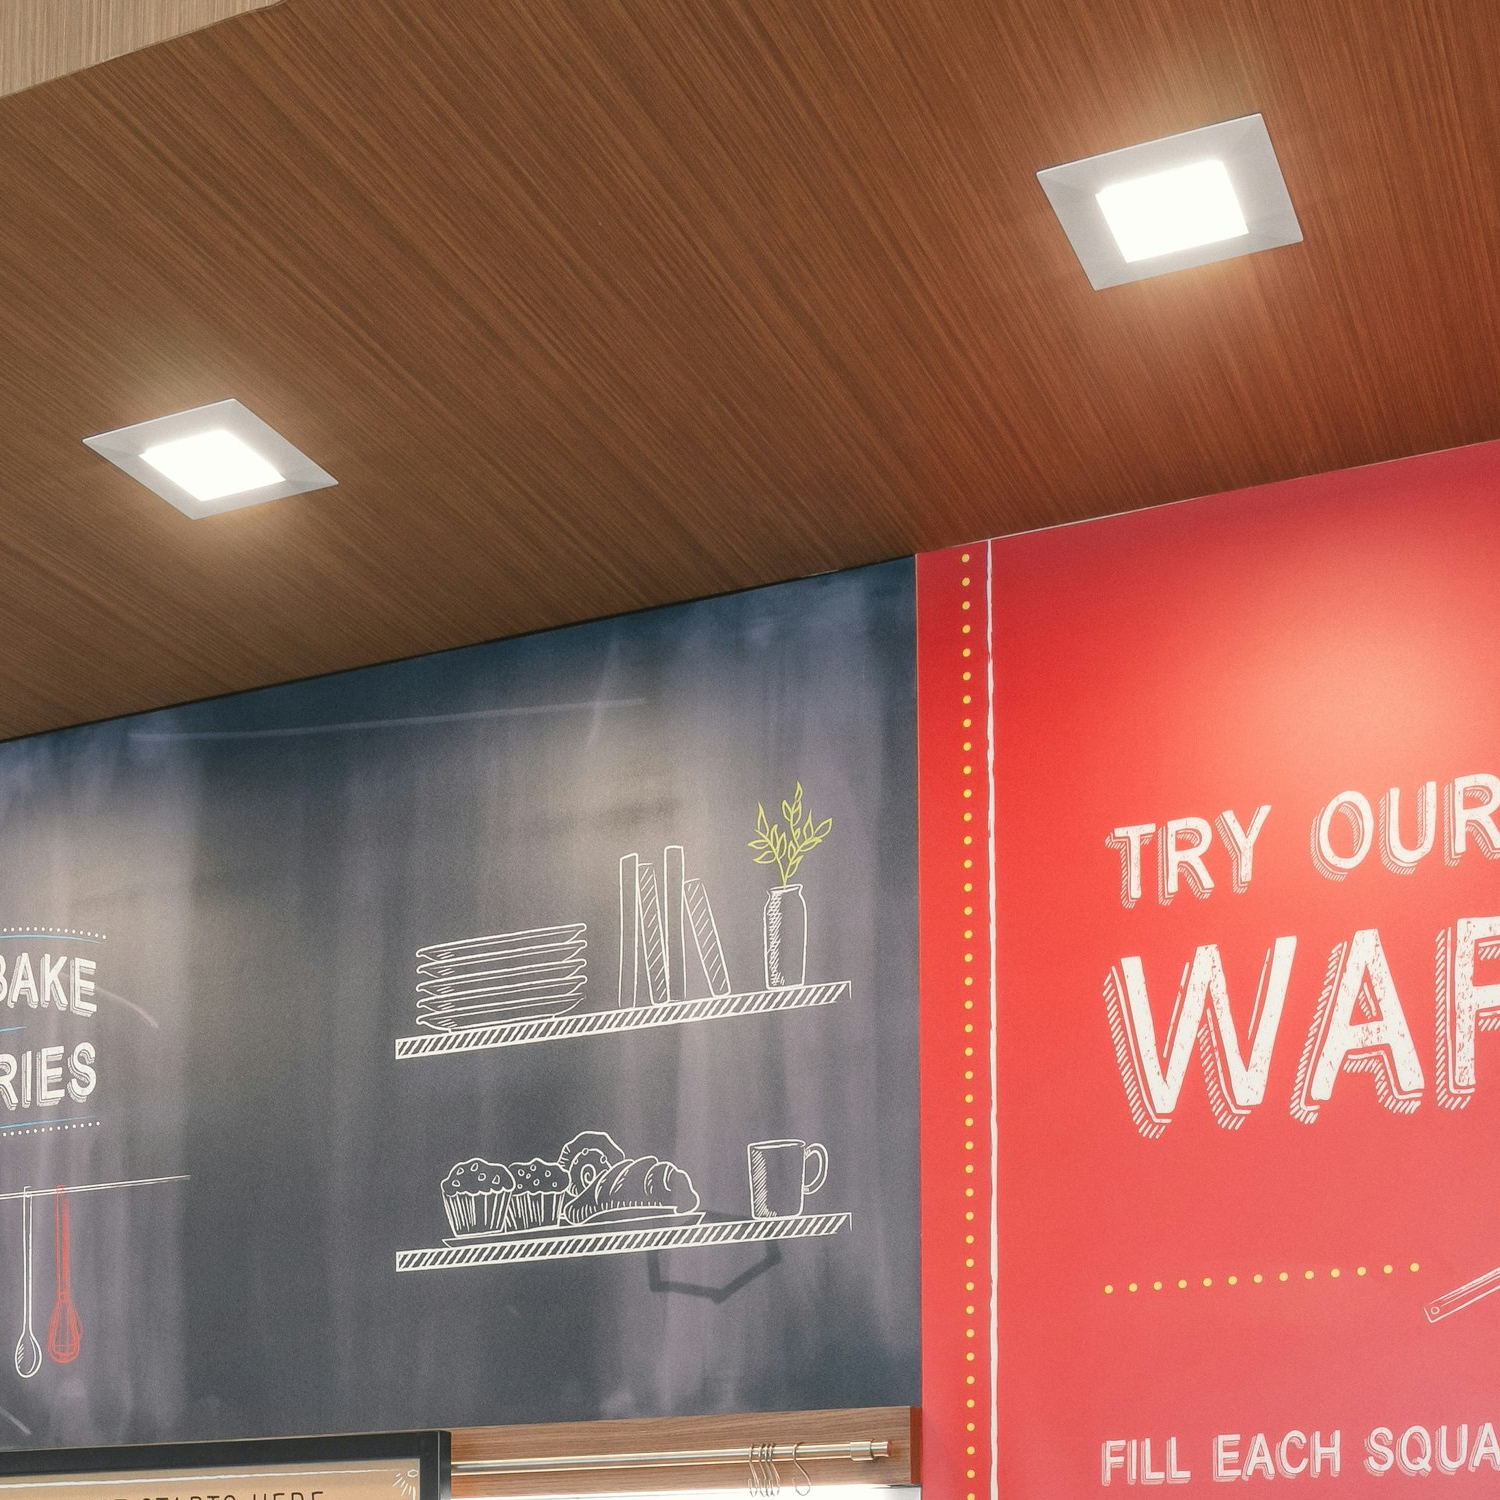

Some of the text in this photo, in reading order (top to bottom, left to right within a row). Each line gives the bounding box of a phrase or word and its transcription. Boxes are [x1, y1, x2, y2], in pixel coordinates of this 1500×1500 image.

[1104, 805, 1272, 908] TRY
[1102, 1434, 1190, 1486] FILL
[1213, 1429, 1341, 1482] EACH
